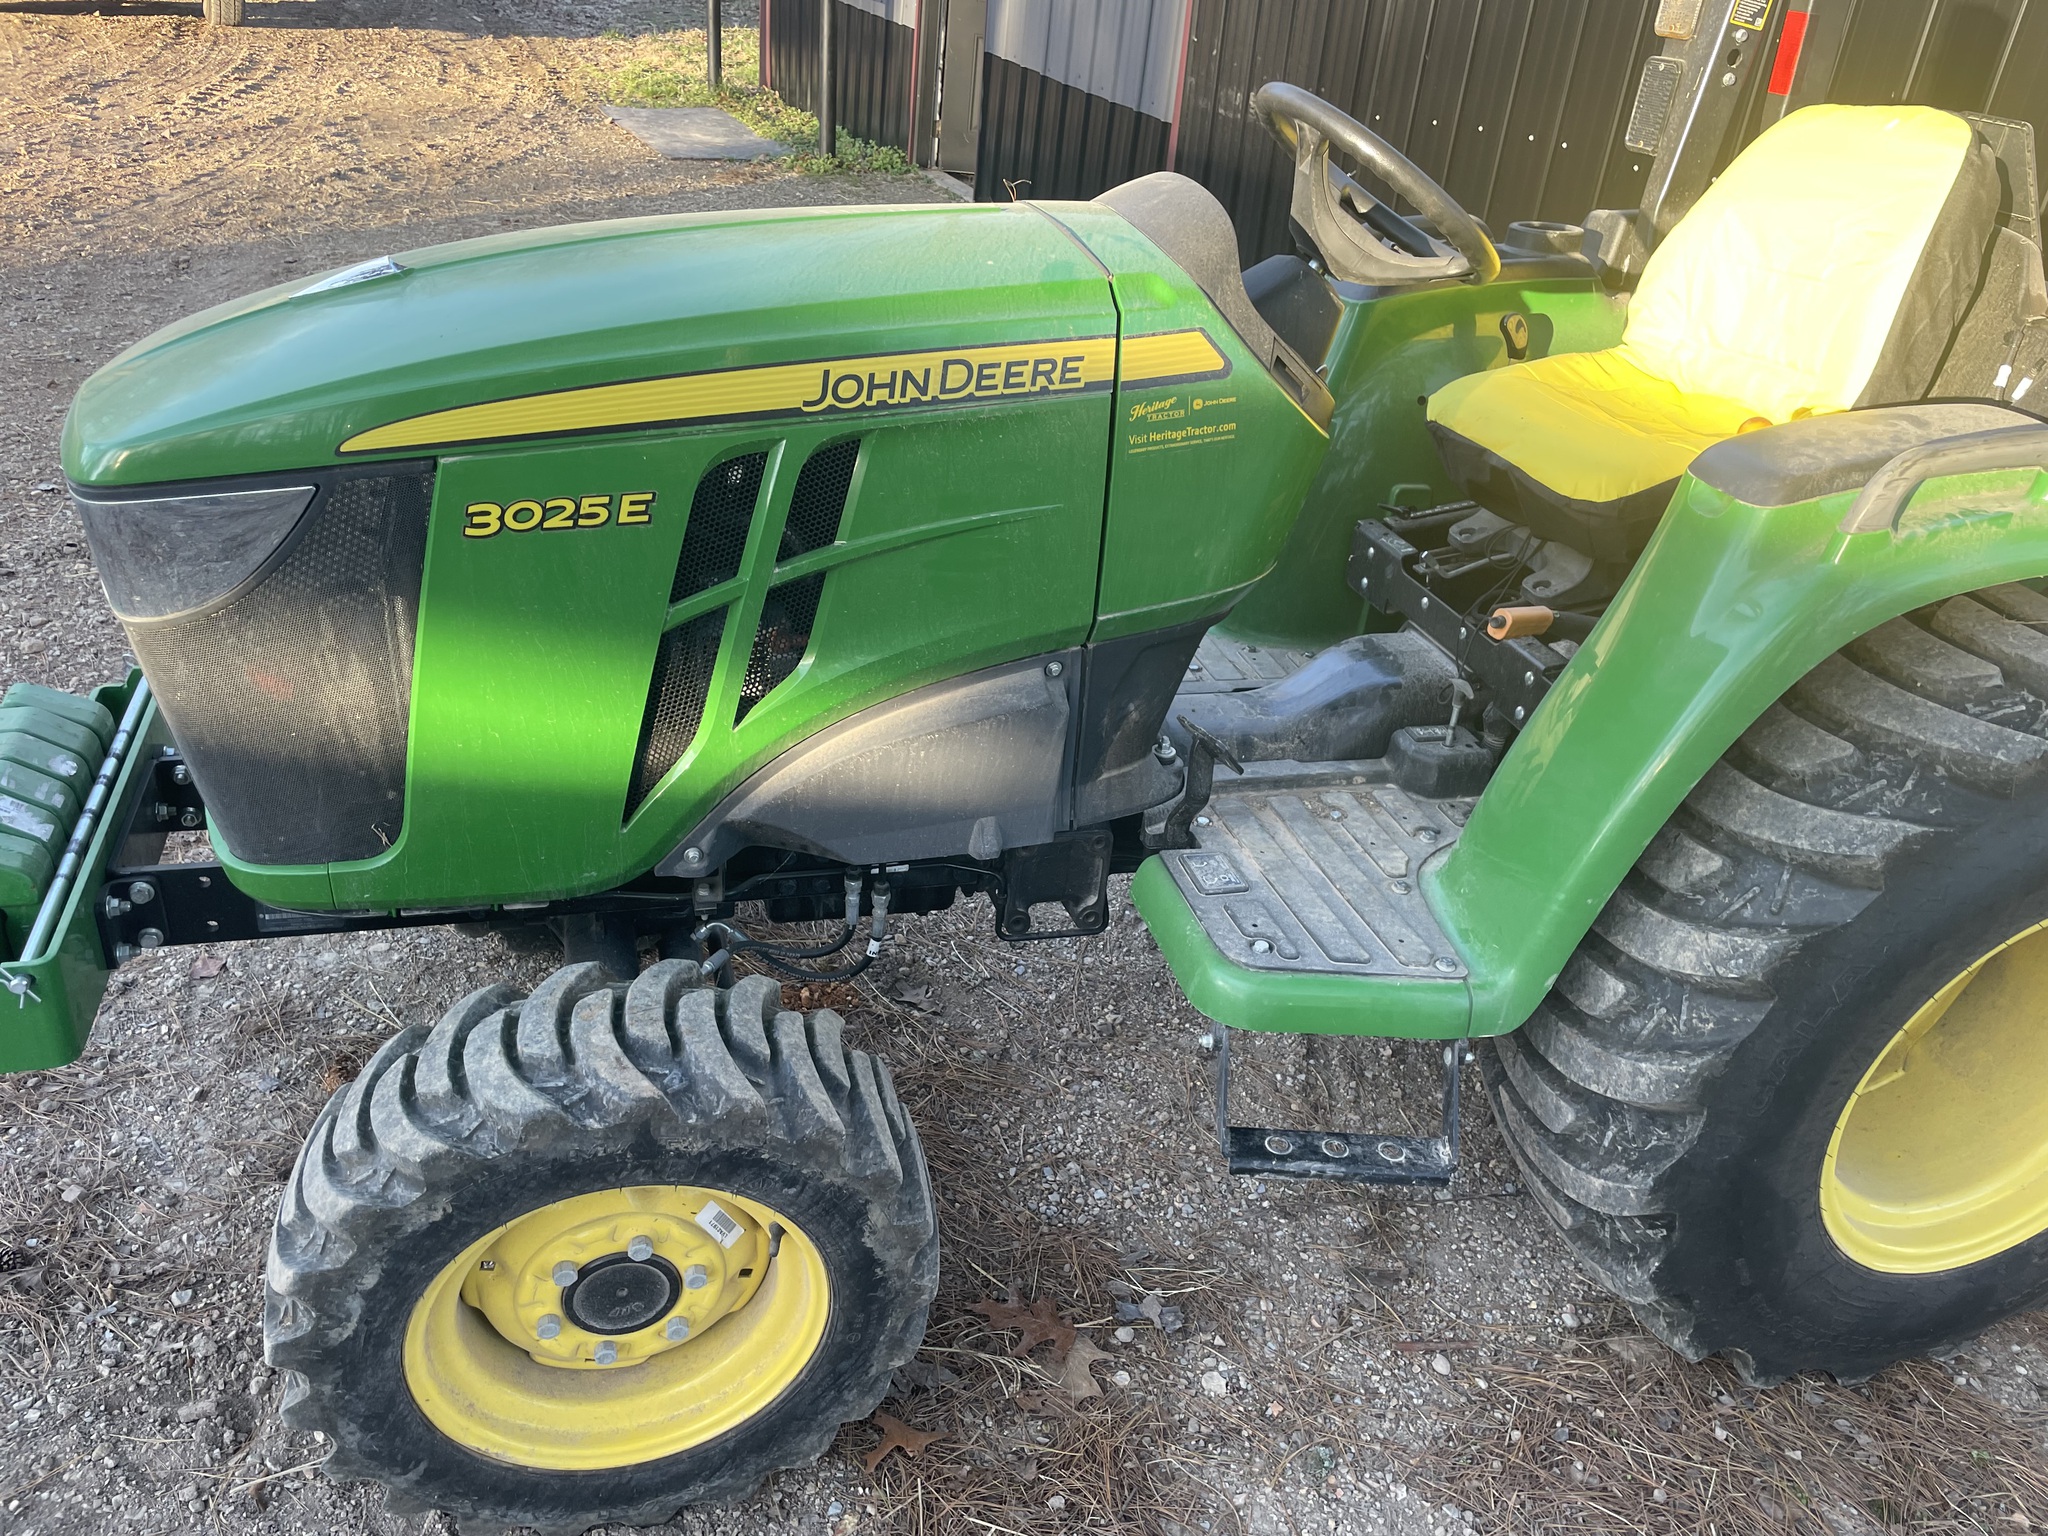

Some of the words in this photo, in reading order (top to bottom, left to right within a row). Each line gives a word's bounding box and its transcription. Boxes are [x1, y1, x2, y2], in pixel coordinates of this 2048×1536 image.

[801, 367, 932, 411] JOHN
[938, 355, 1086, 398] DEERE
[1128, 396, 1178, 422] Heritage
[1147, 410, 1185, 422] TRACTOR
[1128, 434, 1148, 445] Visit
[1149, 422, 1237, 442] HeritageTractor.com
